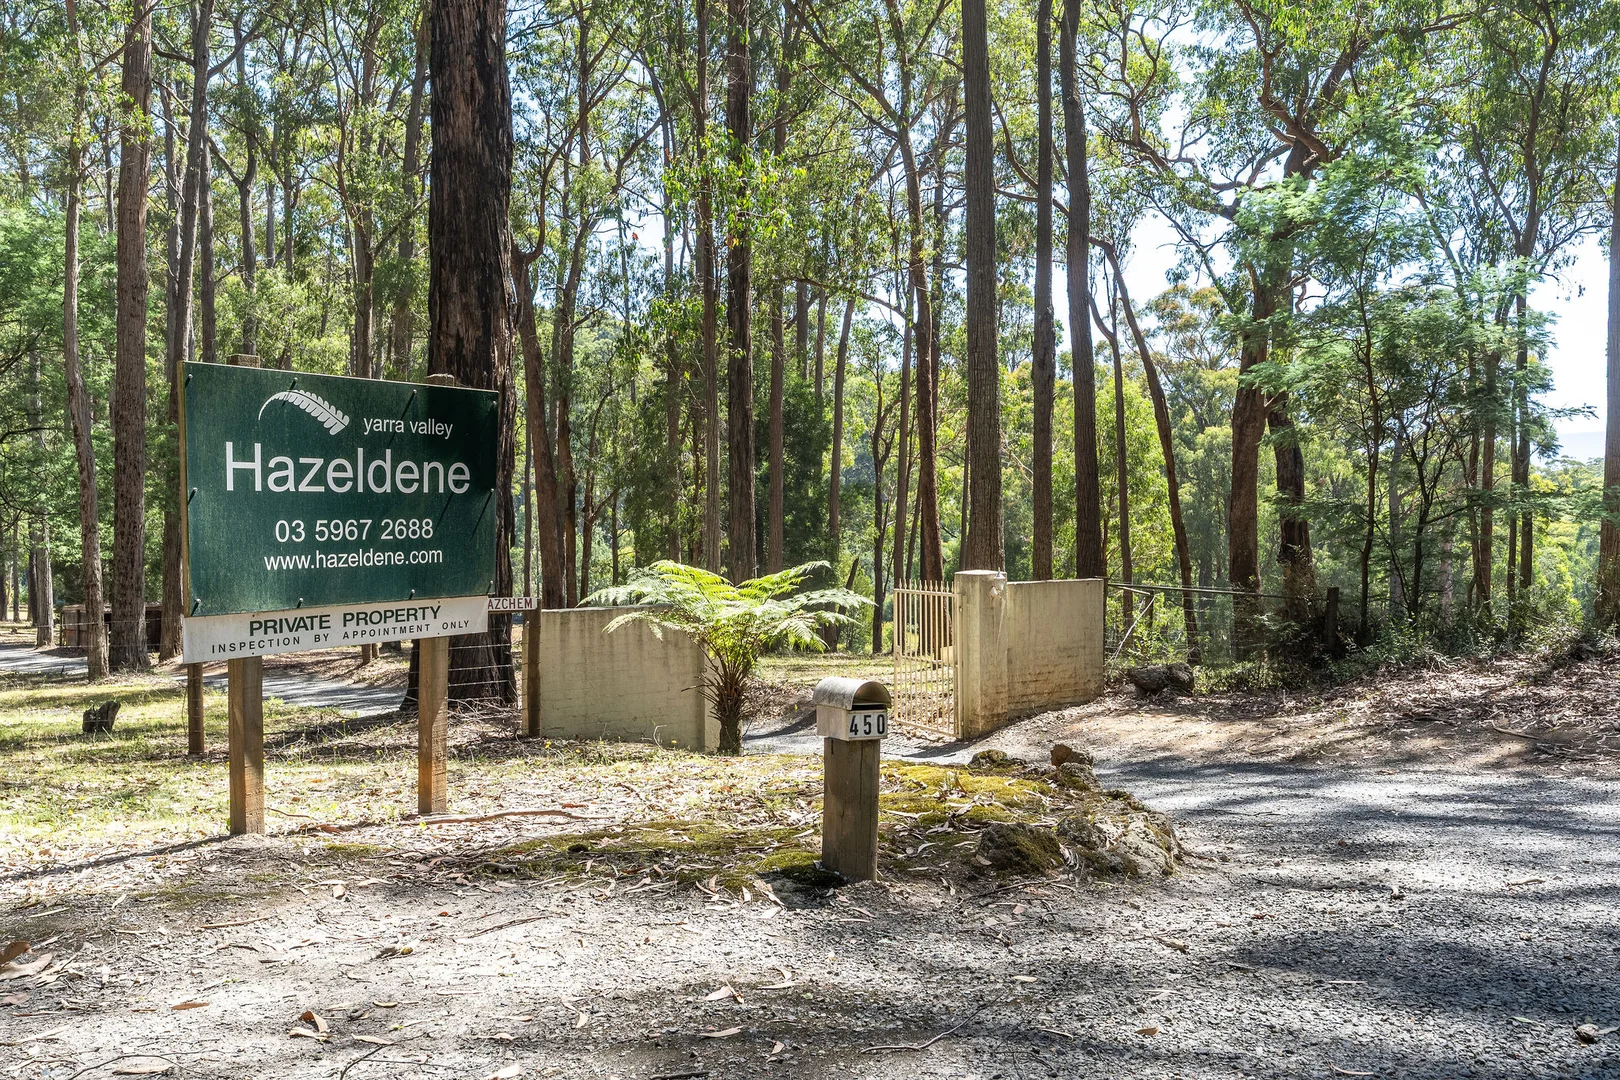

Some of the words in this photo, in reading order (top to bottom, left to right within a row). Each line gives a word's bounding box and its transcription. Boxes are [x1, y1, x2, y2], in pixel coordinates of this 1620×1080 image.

[363, 417, 404, 435] yarra
[409, 418, 453, 439] valley
[225, 441, 471, 494] Hazeldene
[274, 520, 305, 542] 03
[315, 519, 373, 541] 5967
[380, 518, 434, 540] 2688
[264, 548, 443, 571] www.hazeldene.com
[249, 614, 331, 637] PRIVATE
[342, 605, 441, 627] PROPERTY
[211, 635, 300, 653] INSPECTION
[314, 633, 329, 643] BY
[342, 623, 430, 640] APPOINTMENT
[442, 619, 470, 630] ONLY
[849, 714, 885, 736] 450
